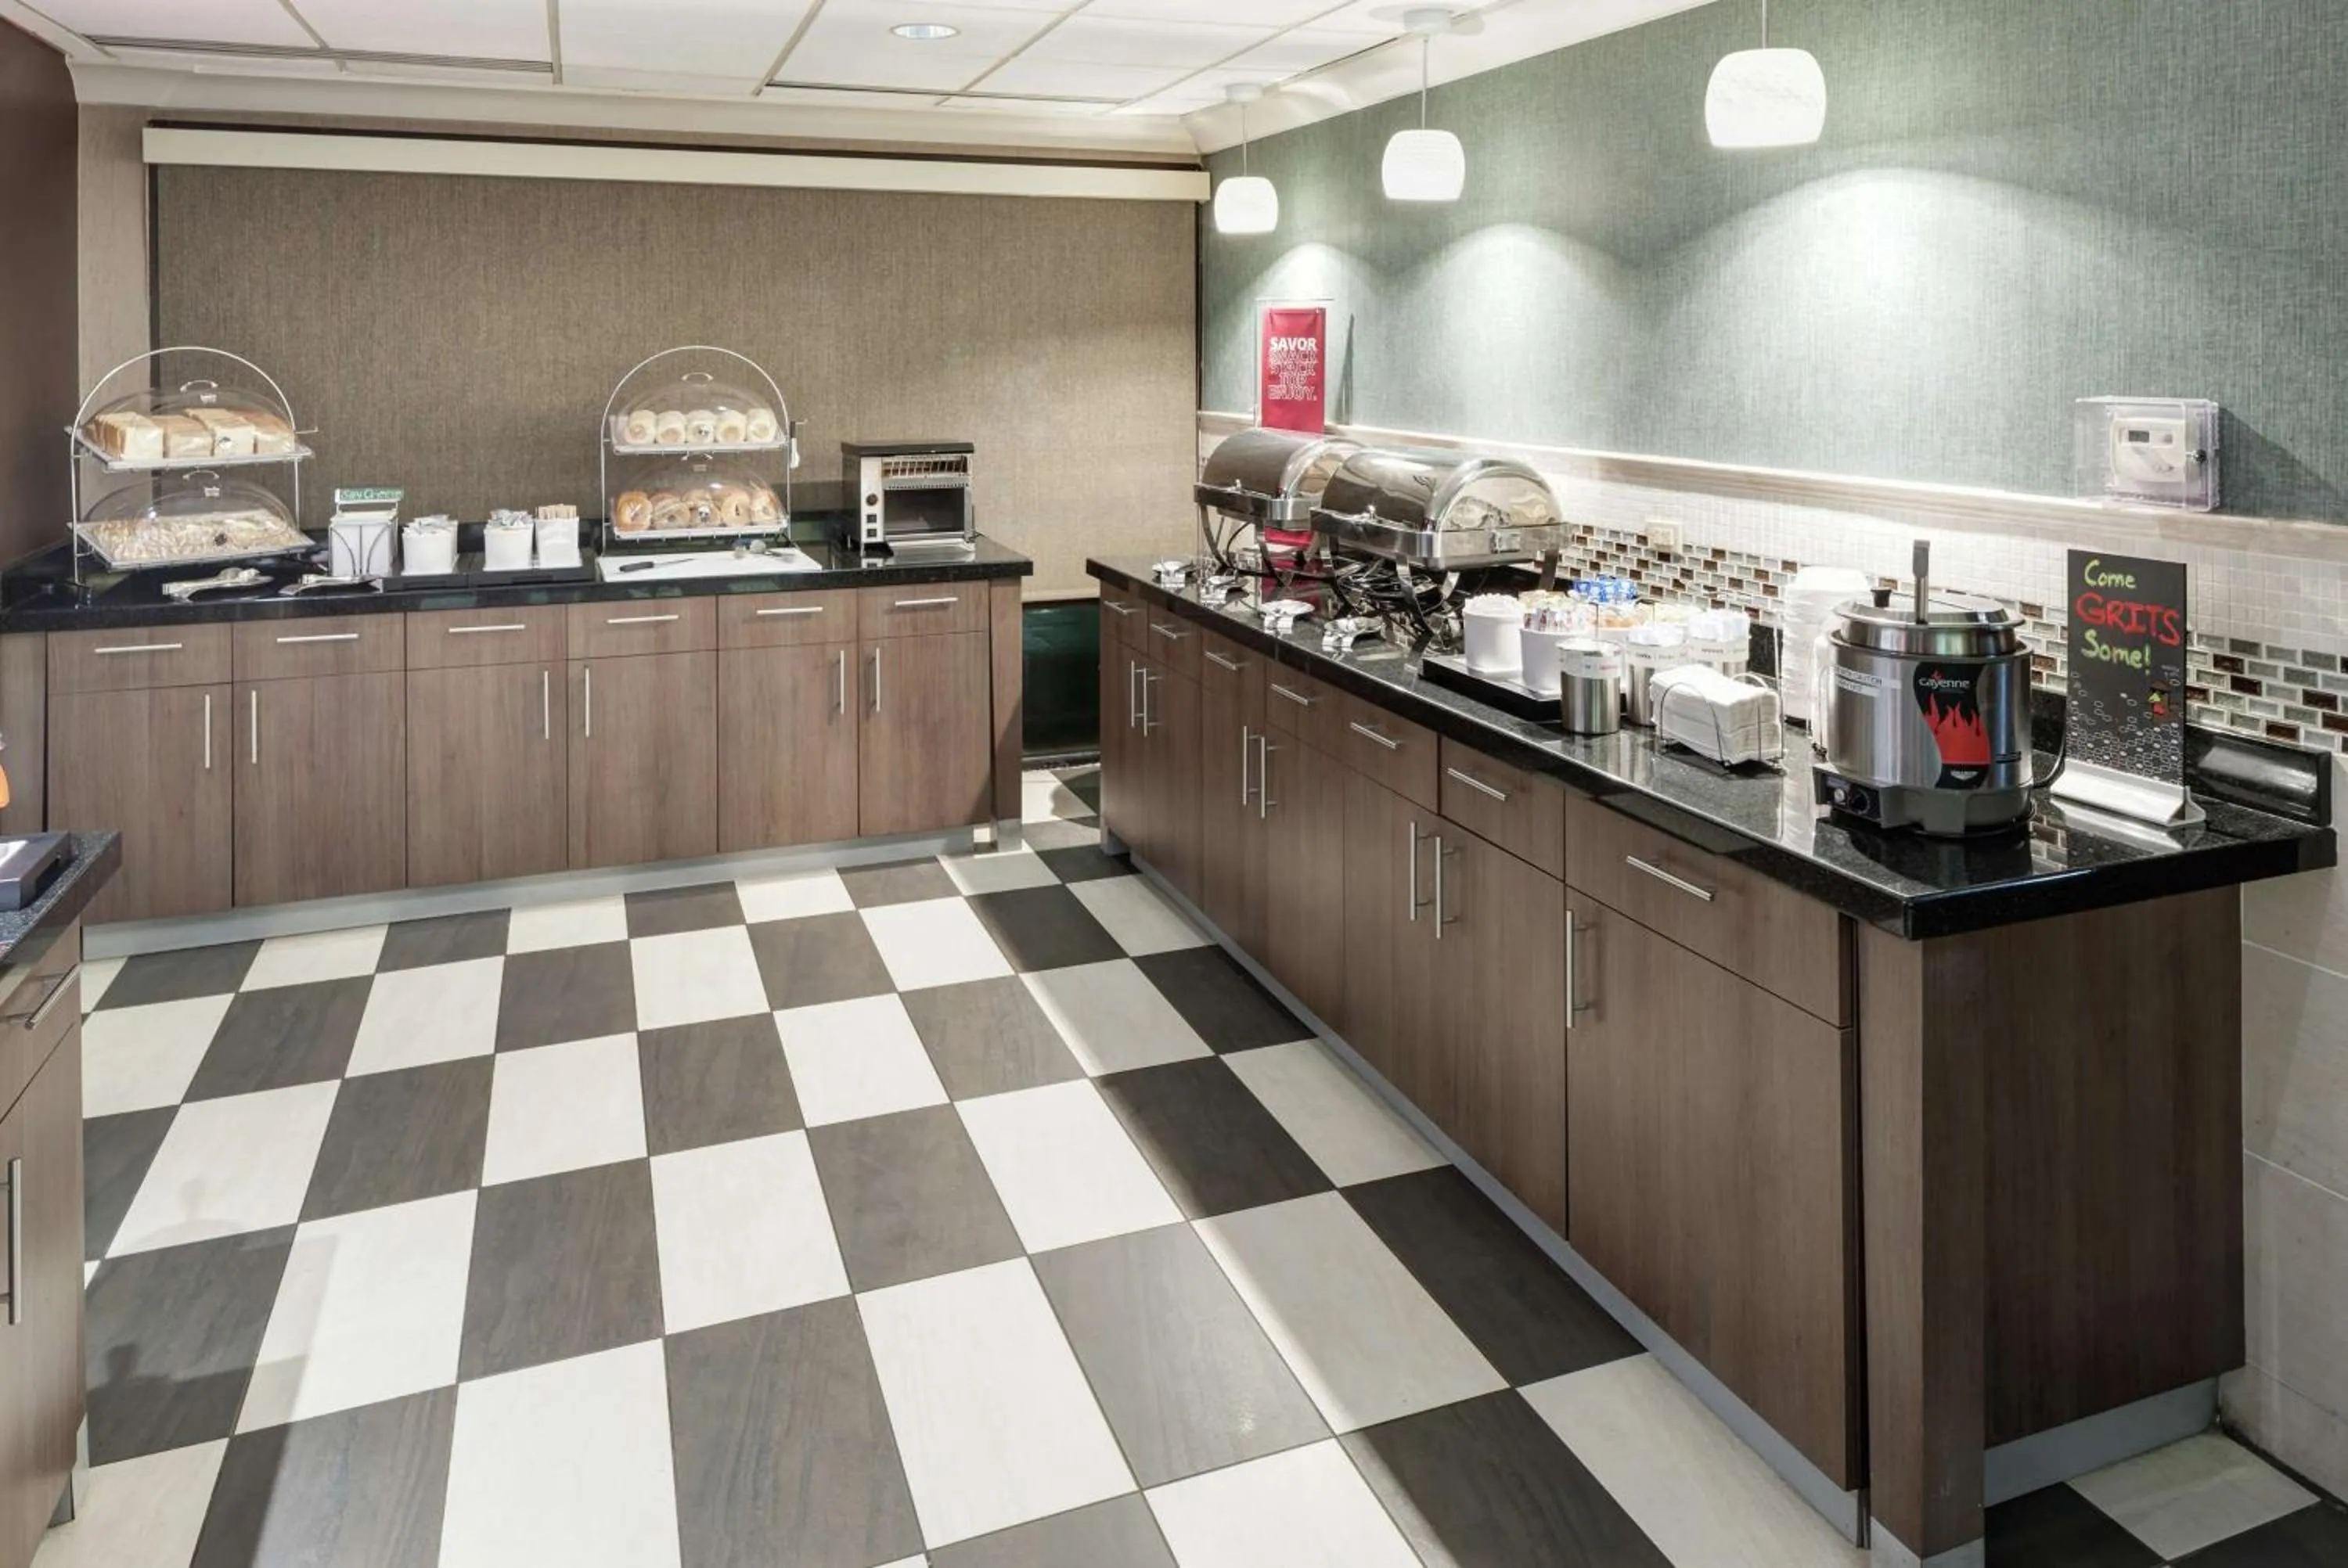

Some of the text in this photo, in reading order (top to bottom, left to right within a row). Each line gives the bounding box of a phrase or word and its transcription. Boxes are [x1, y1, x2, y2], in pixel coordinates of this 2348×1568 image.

[1269, 337, 1318, 351] SAVOR
[2084, 559, 2137, 588] Come
[2076, 592, 2181, 646] GRITS
[2080, 629, 2152, 676] Some!
